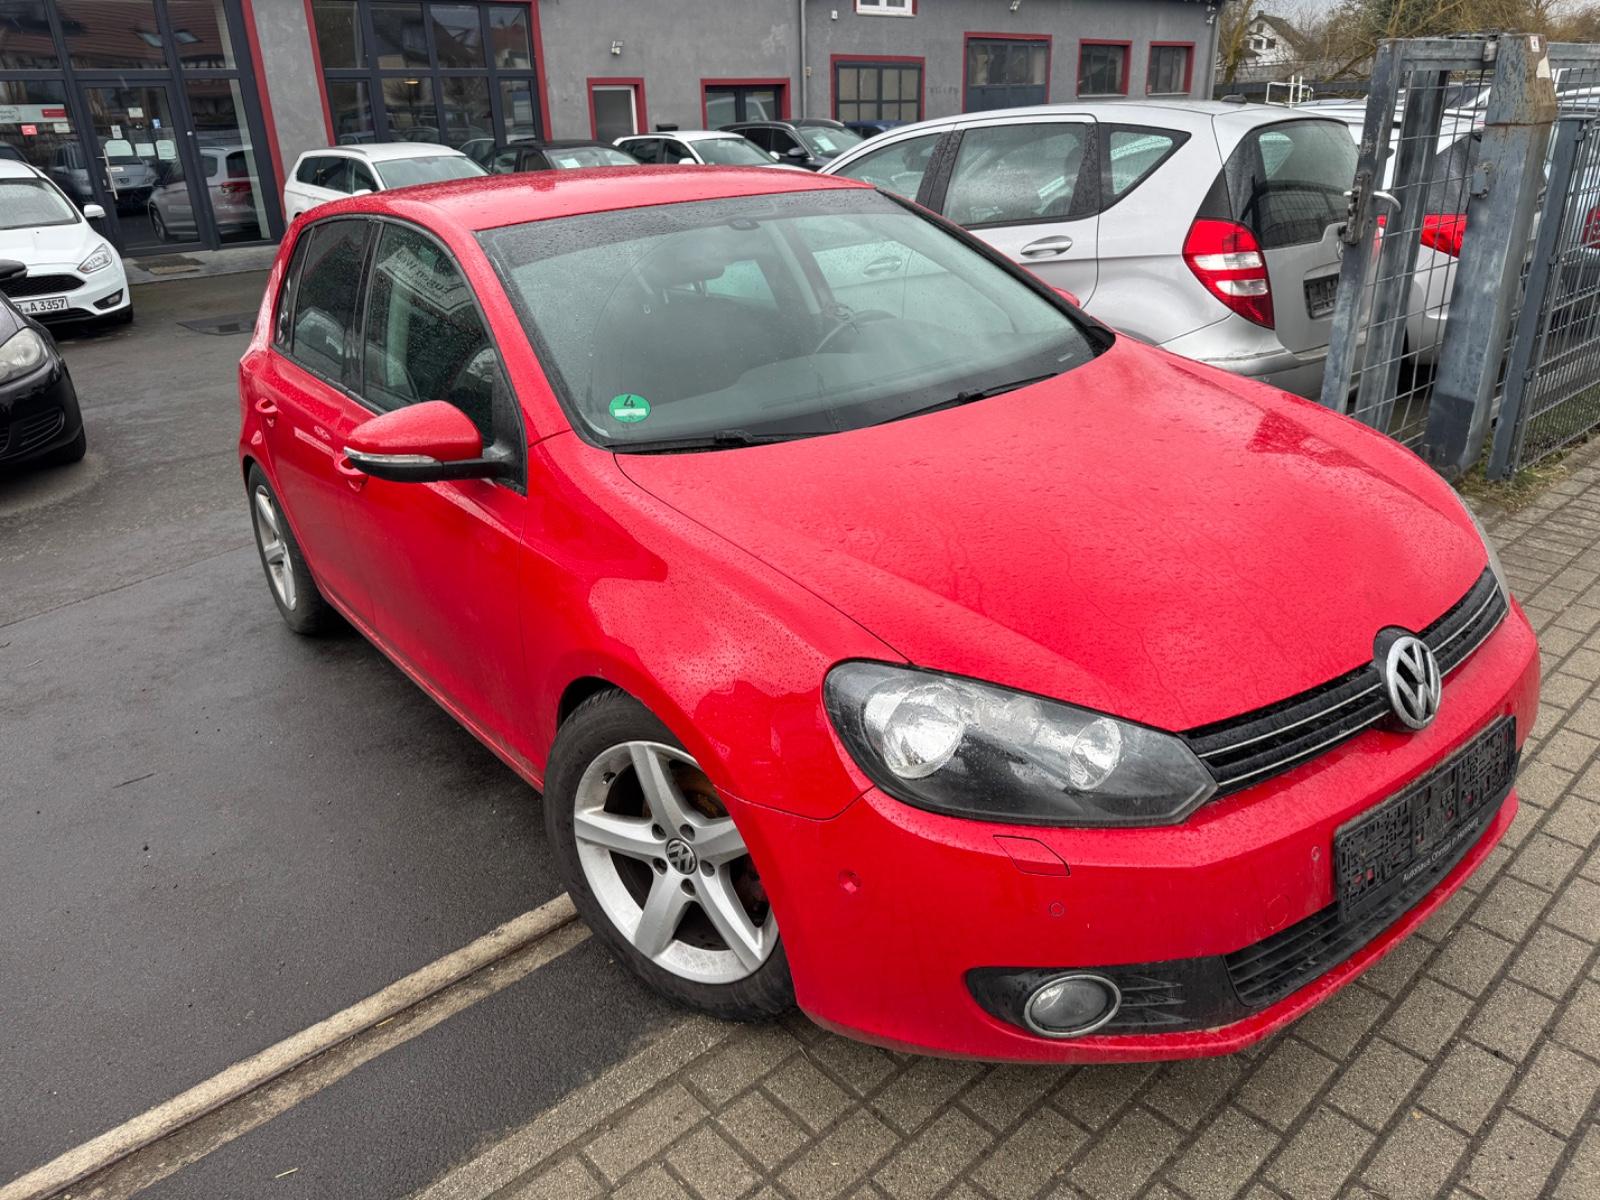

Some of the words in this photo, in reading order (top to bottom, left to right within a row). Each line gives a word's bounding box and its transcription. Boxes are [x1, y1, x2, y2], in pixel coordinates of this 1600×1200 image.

[30, 302, 38, 312] A
[39, 299, 65, 311] 3357
[623, 394, 636, 408] 4
